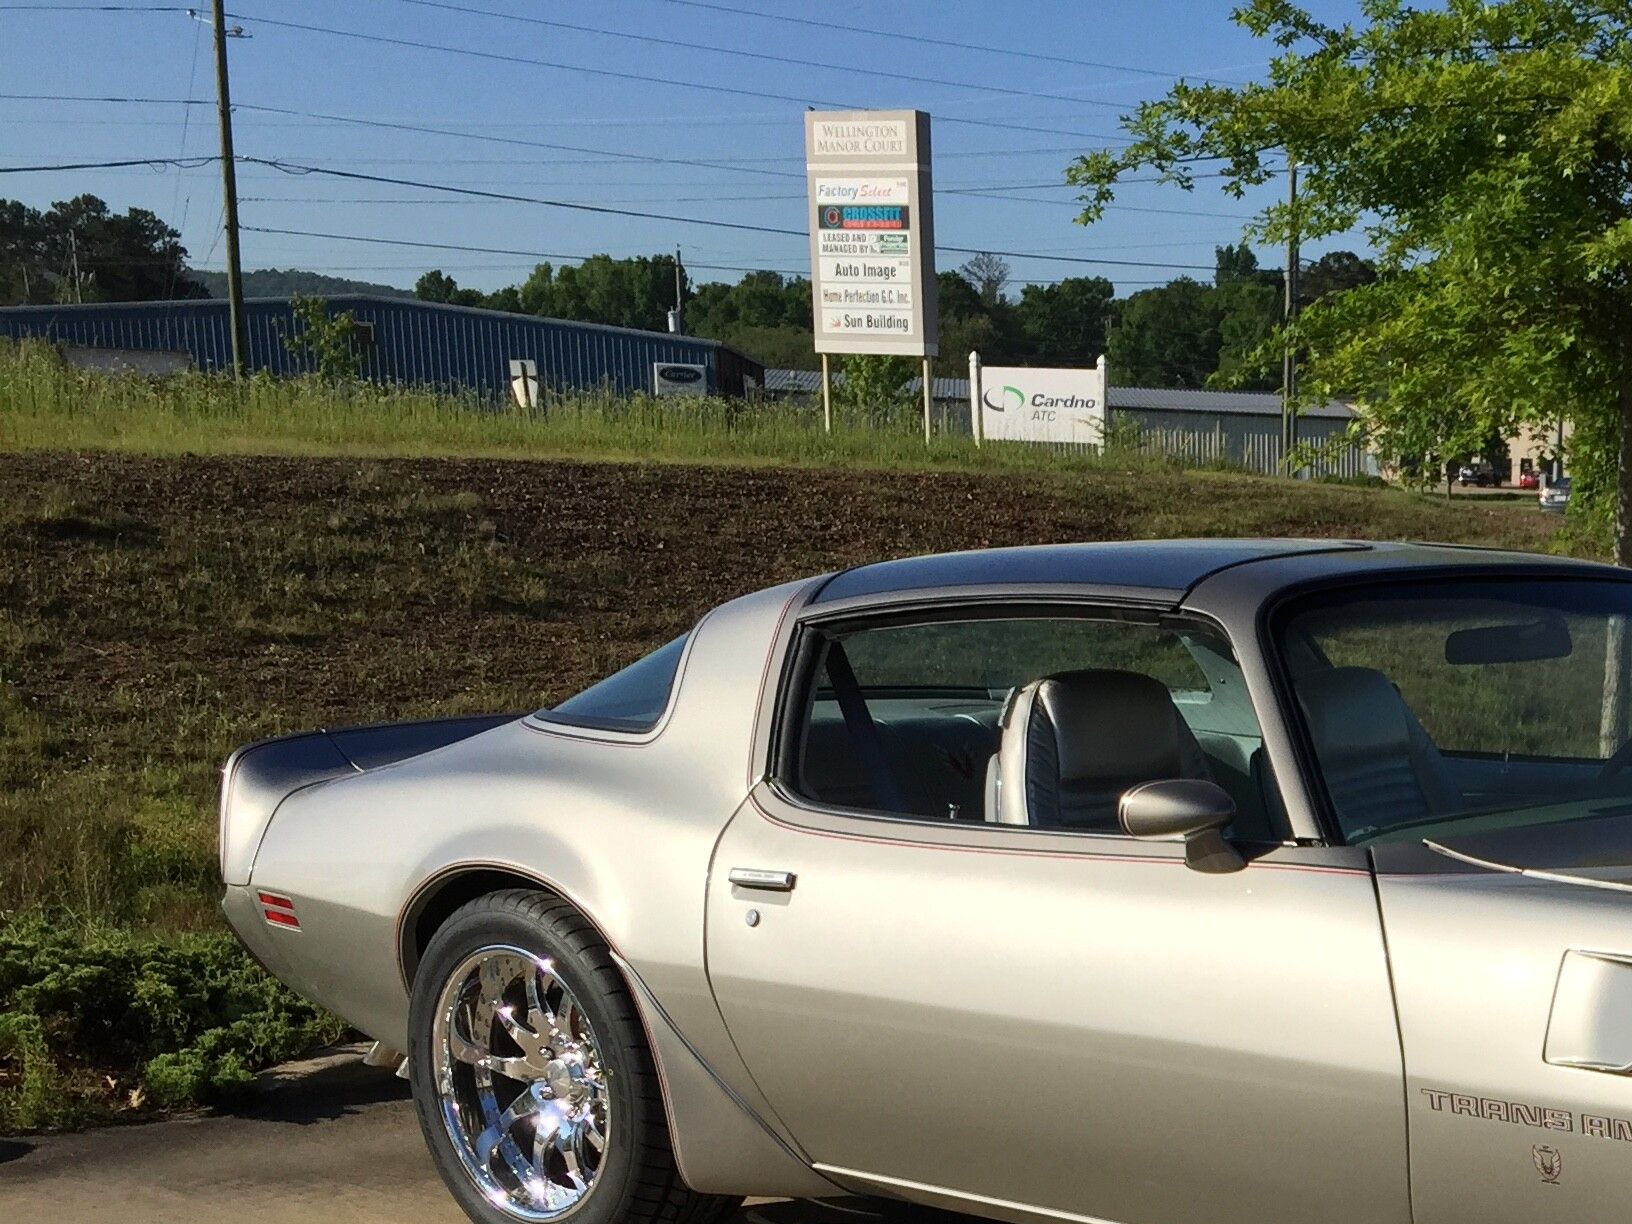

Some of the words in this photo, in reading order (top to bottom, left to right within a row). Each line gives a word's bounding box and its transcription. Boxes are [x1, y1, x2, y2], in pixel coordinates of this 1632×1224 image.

[822, 125, 898, 138] WELLINGTON
[817, 139, 860, 152] MANOR
[864, 138, 903, 152] COURT
[819, 184, 858, 200] Factory
[860, 184, 892, 197] Select
[843, 207, 901, 220] CROSSFIT
[823, 233, 850, 242] LEASED
[852, 234, 866, 242] AND
[822, 244, 857, 253] MANAGED
[860, 244, 868, 253] BY
[835, 263, 859, 277] Auto
[864, 264, 897, 280] Image
[823, 288, 842, 302] Home
[844, 289, 879, 303] Perfection
[897, 290, 910, 303] Inc.
[844, 315, 863, 329] Sun
[866, 315, 908, 332] Building
[1031, 393, 1095, 409] Cardno
[1031, 410, 1056, 422] ATC
[1420, 1088, 1574, 1132] TRANS
